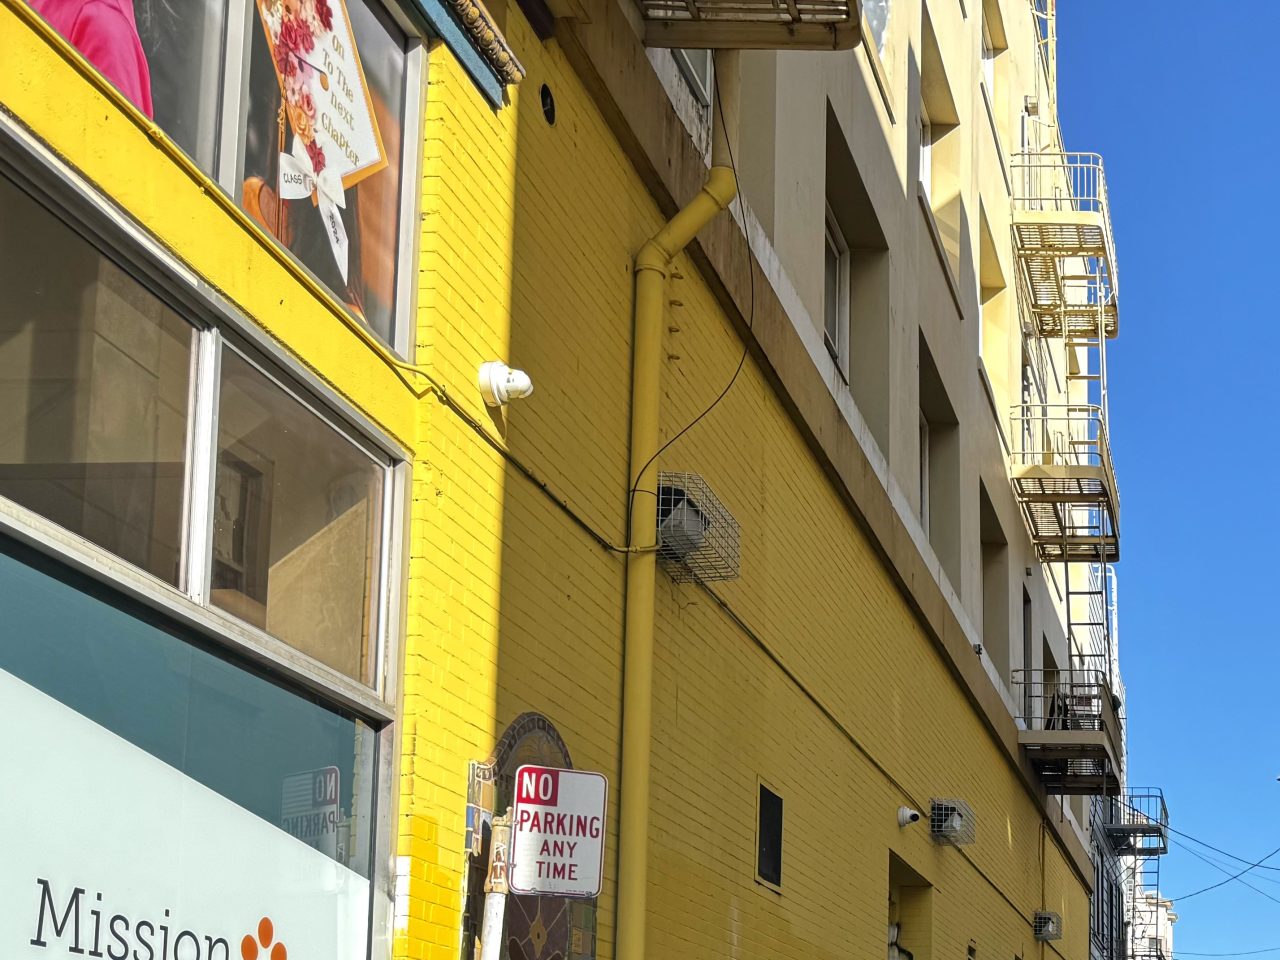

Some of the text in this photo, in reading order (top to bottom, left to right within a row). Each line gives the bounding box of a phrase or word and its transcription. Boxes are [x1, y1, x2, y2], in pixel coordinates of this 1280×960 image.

[337, 67, 354, 103] The
[522, 772, 553, 801] NO
[519, 810, 600, 838] PARKING
[540, 839, 578, 858] ANY
[536, 861, 578, 880] TIME
